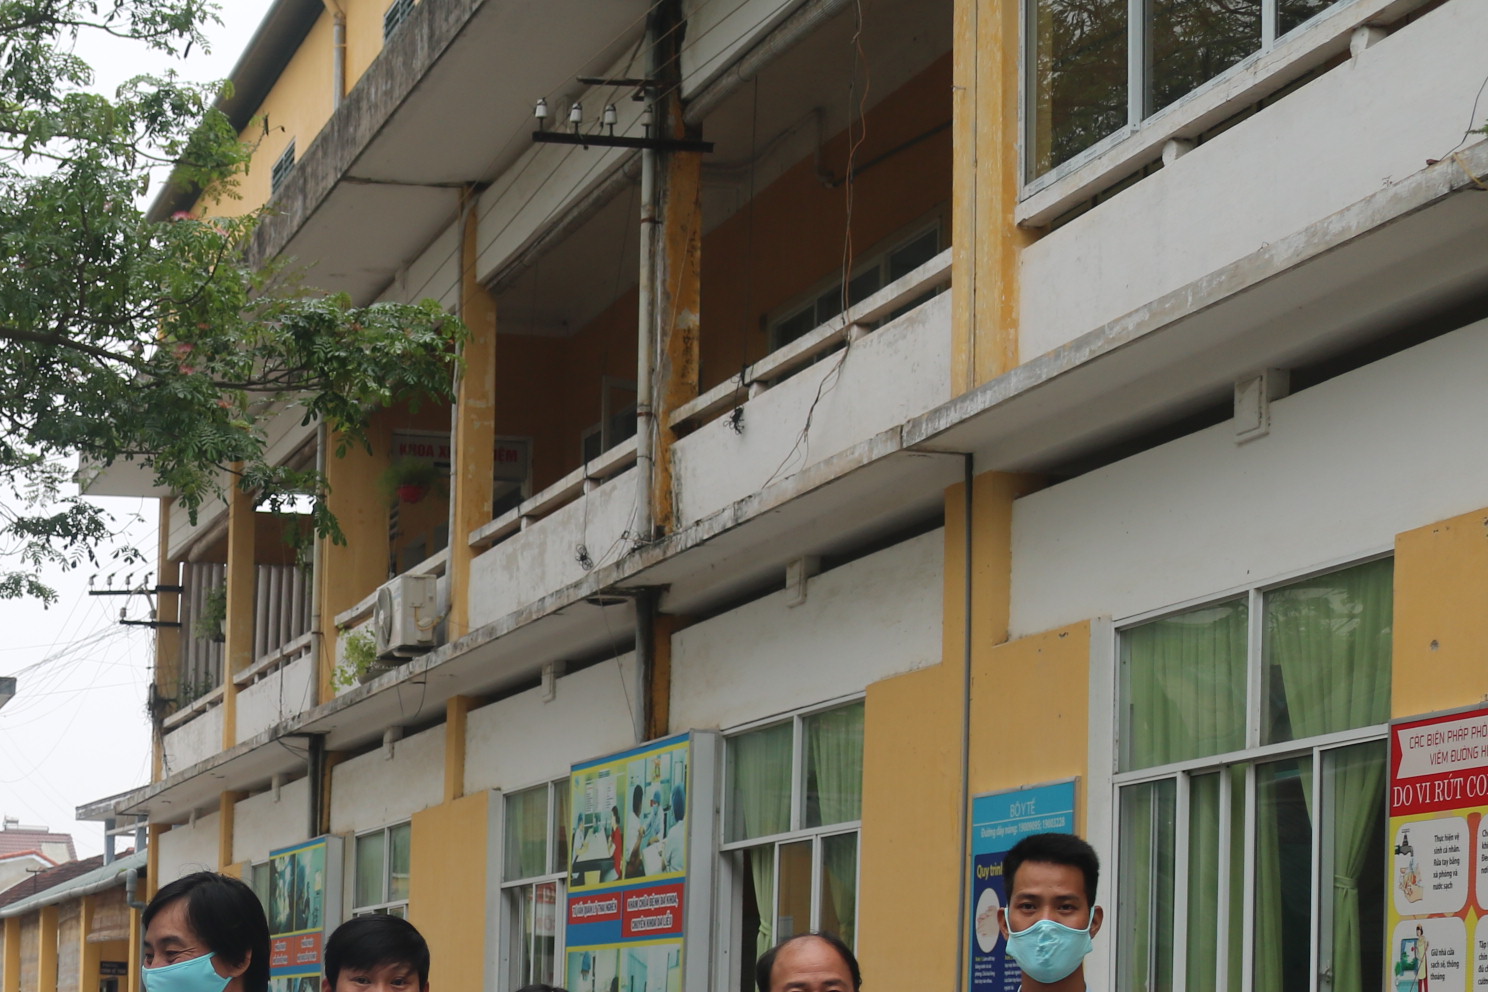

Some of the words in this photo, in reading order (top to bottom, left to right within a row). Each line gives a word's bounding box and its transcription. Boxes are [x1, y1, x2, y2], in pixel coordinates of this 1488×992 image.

[399, 443, 434, 457] KHOA
[1409, 734, 1424, 749] CÁC
[1448, 726, 1468, 742] PHÁP
[1430, 749, 1448, 765] VIÊM
[1393, 784, 1413, 807] DO
[1416, 782, 1430, 804] VI
[1434, 773, 1463, 802] RÚT
[977, 864, 989, 880] Quy
